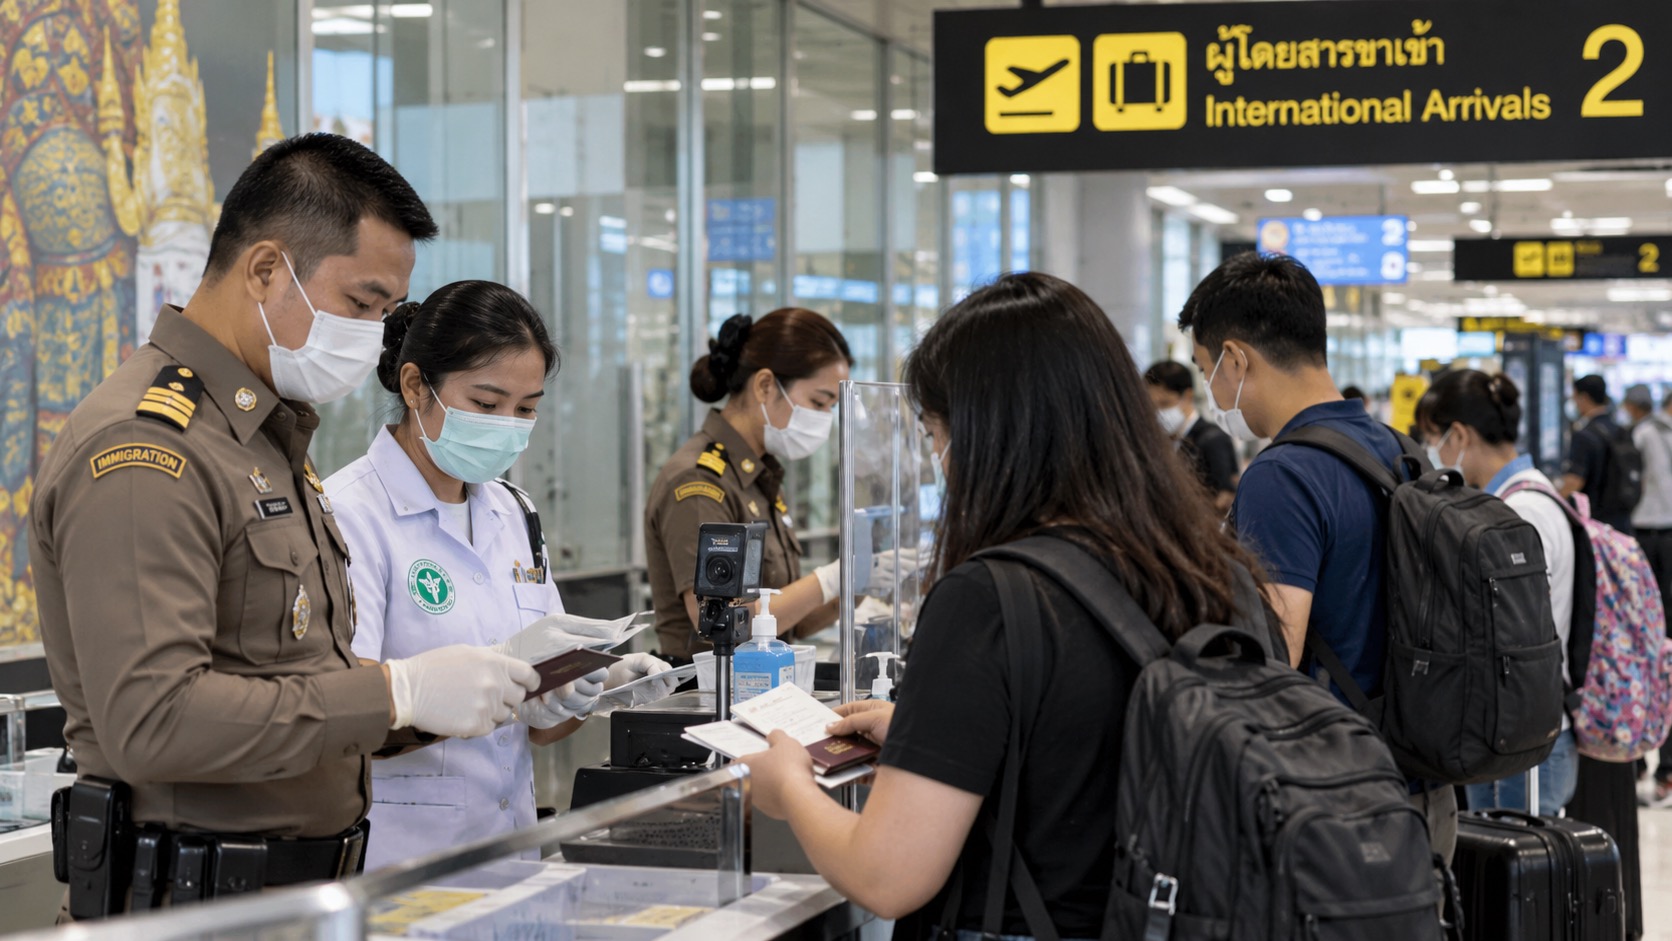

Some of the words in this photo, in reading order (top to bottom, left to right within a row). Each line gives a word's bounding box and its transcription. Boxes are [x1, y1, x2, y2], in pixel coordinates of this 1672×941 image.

[1206, 18, 1445, 86] ผู้โดยสารขาเข้า
[1580, 23, 1645, 118] 2
[1205, 89, 1412, 128] International
[1421, 86, 1552, 122] Arrivals
[1638, 242, 1660, 273] 2
[97, 448, 178, 470] IMMIGRATION
